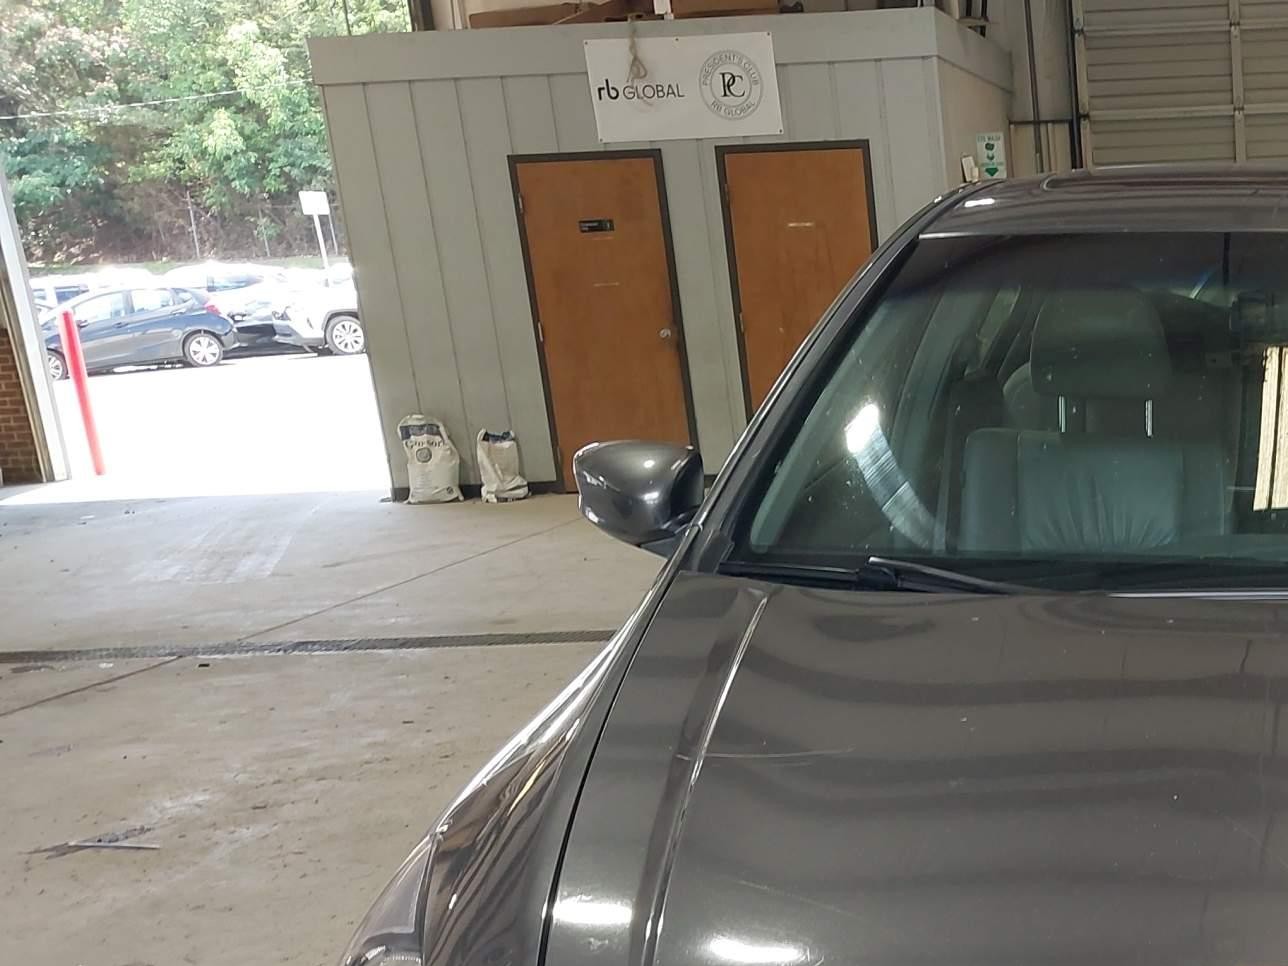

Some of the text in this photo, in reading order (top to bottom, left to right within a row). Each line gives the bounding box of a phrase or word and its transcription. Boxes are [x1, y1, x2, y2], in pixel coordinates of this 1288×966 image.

[597, 78, 685, 101] rb GLOBAL
[719, 71, 746, 98] PC
